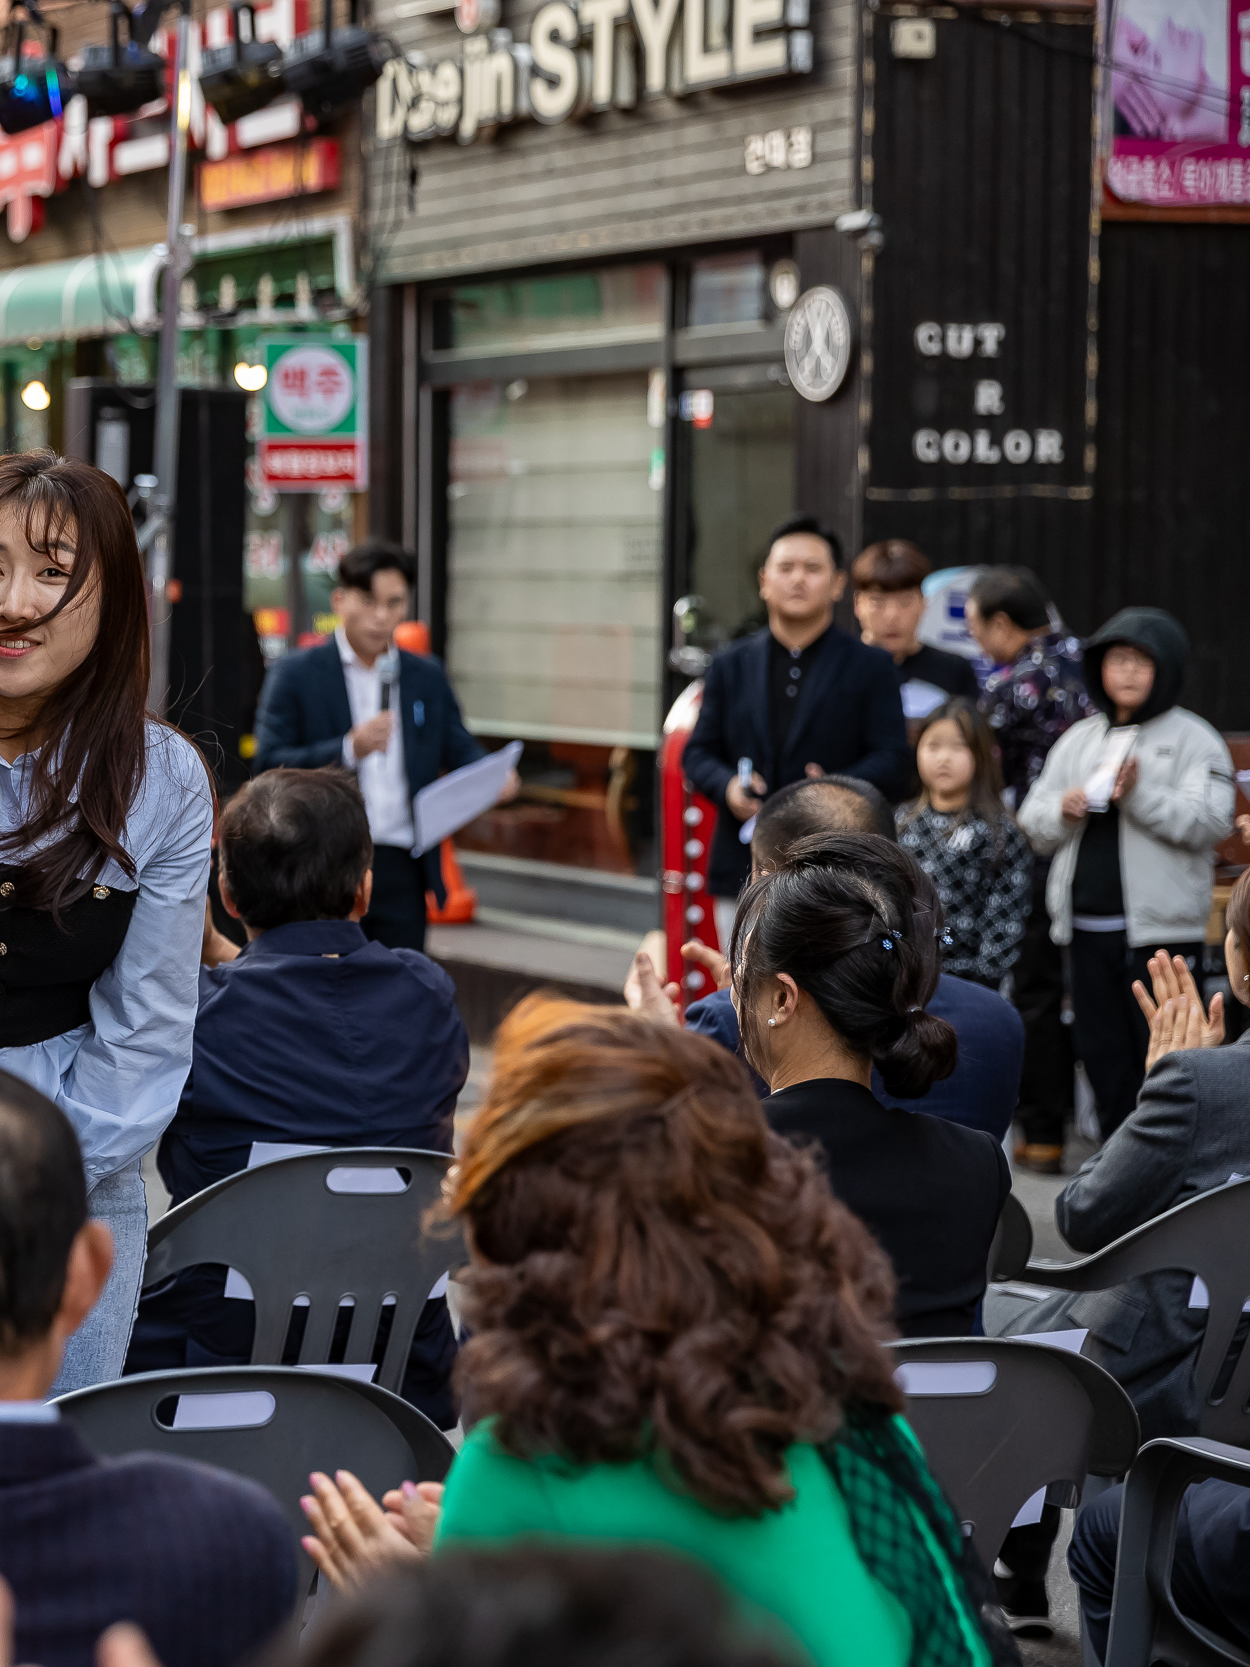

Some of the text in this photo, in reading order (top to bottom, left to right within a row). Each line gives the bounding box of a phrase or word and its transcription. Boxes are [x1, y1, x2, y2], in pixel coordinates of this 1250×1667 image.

[530, 0, 790, 119] STYLE
[914, 322, 1006, 358] CUT
[912, 428, 1065, 465] COLOR
